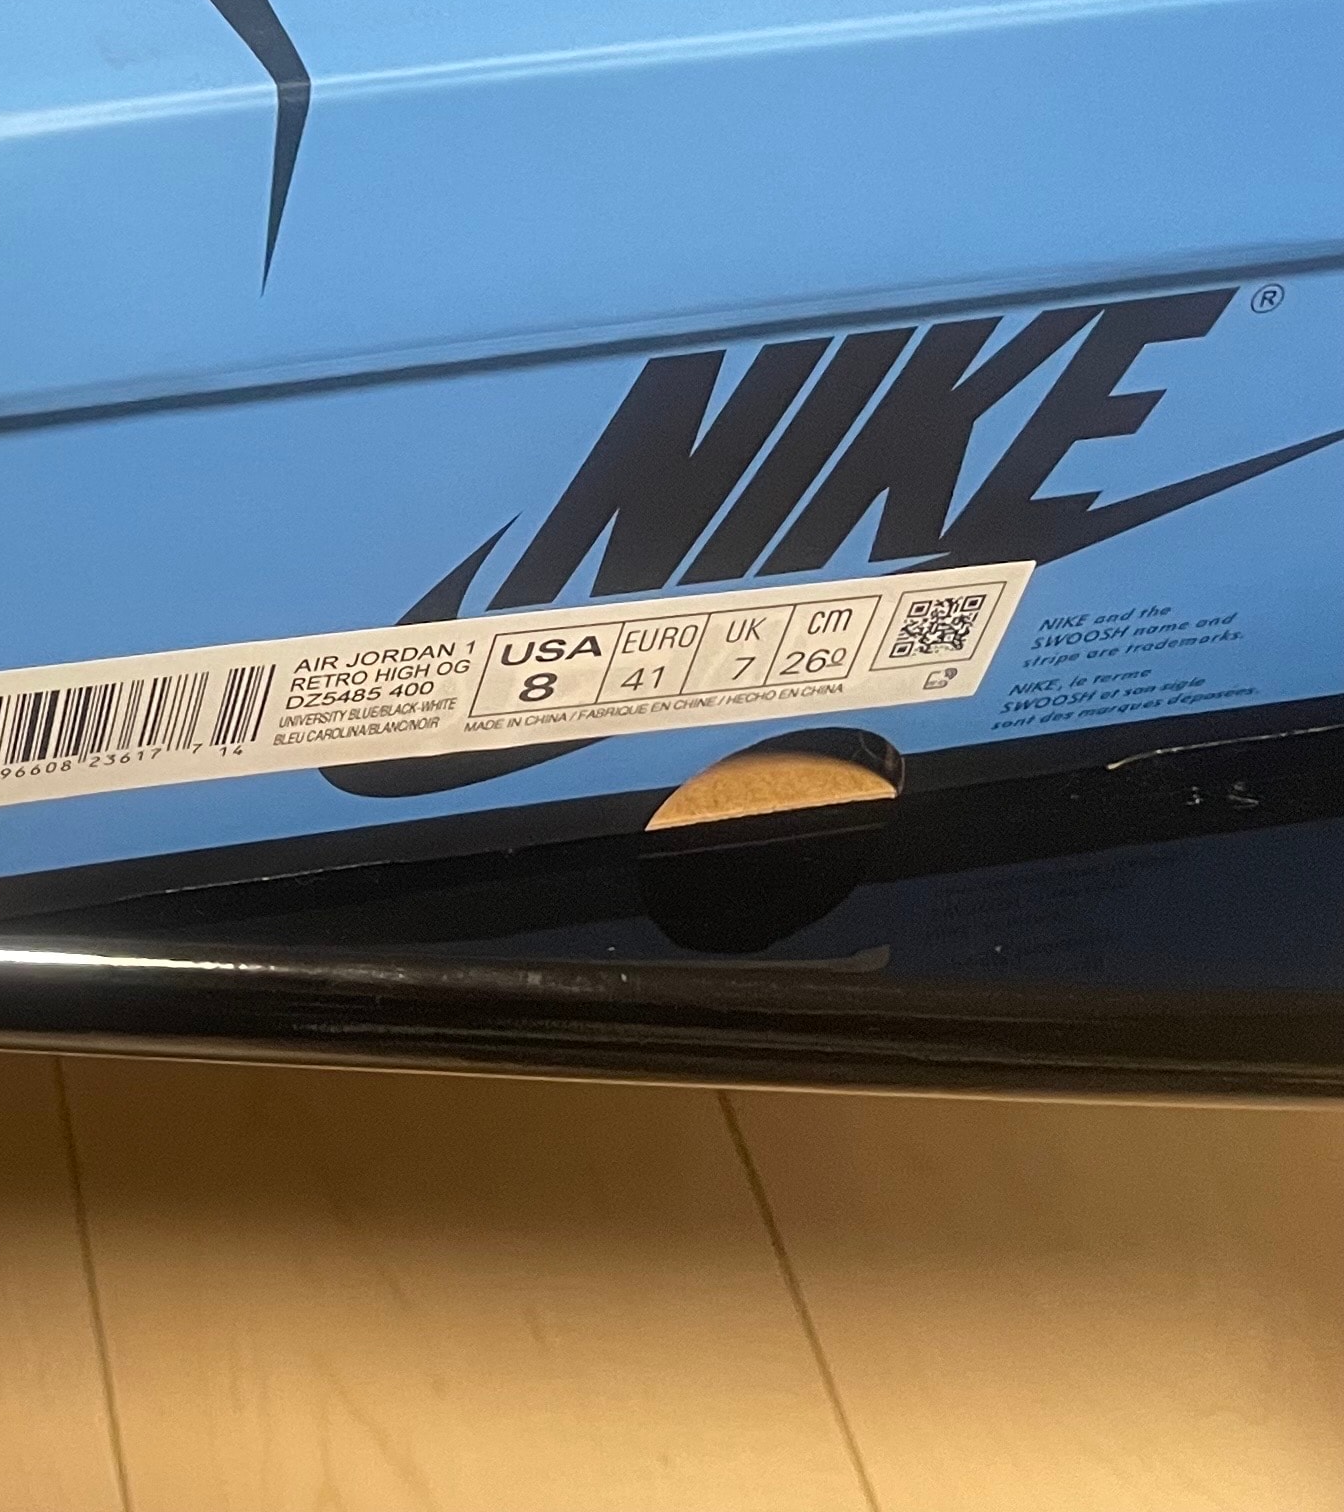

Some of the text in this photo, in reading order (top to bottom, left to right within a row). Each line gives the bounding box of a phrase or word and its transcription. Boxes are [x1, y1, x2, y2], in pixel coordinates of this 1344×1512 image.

[486, 286, 1241, 612] NIKE
[725, 617, 767, 643] UK
[1030, 612, 1239, 651] SWOOSH name and
[1038, 605, 1172, 632] NIKE and the
[500, 635, 603, 666] USA
[621, 624, 699, 654] EURO
[1022, 630, 1244, 669] stripe are trademarks.
[293, 640, 476, 674] AIR JORDAN 1
[732, 656, 756, 681] 7
[290, 659, 471, 692] RETRO HIGH OG
[518, 672, 558, 703] 8
[620, 665, 666, 691] 41
[1009, 669, 1152, 697] NIKE, le terme
[285, 680, 434, 710] DZ5485 400
[463, 718, 505, 733] MADE
[506, 716, 523, 728] IN
[523, 711, 567, 727] CHINA
[577, 702, 649, 719] FABRIQUE
[650, 701, 672, 713] EN
[673, 696, 718, 710] CHINE
[726, 689, 777, 705] HECHO
[778, 687, 799, 700] EN
[798, 683, 844, 698] CHINA
[1000, 677, 1207, 715] SWOOSH et son sigle
[278, 709, 348, 728] UNIVERSITY
[991, 716, 1037, 731] sont
[1040, 710, 1075, 723] des
[1078, 698, 1168, 718] marques
[273, 730, 305, 746] BLEU
[0, 760, 72, 780] 96608
[89, 748, 162, 768] 23617
[191, 743, 203, 755] 7
[219, 745, 243, 757] 14
